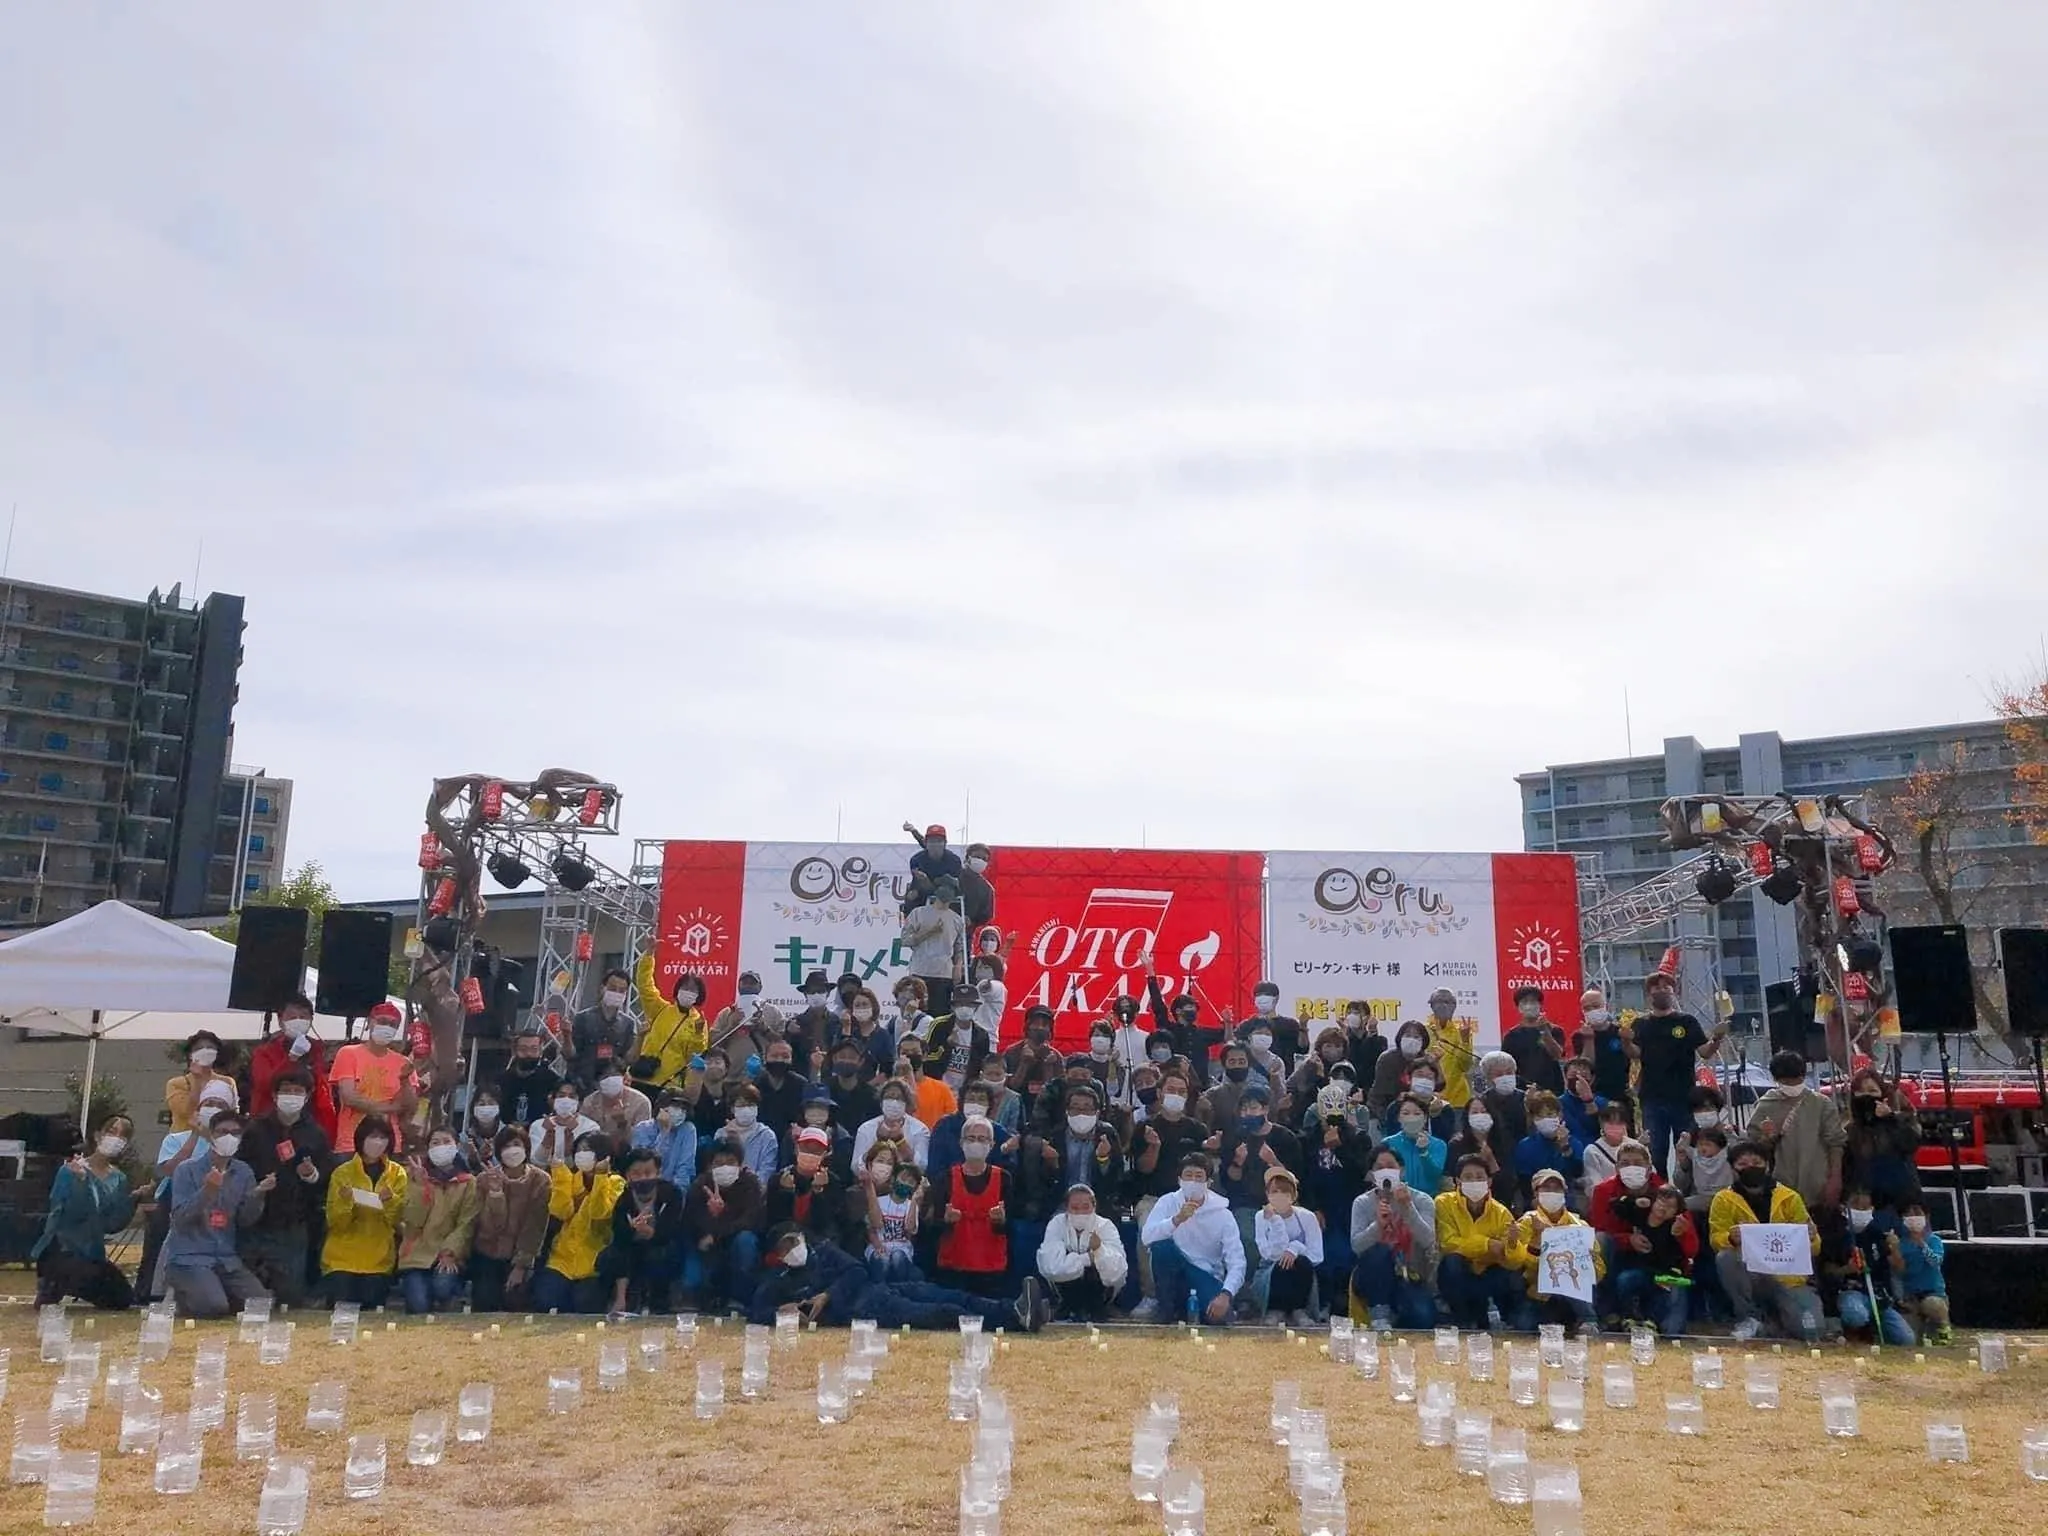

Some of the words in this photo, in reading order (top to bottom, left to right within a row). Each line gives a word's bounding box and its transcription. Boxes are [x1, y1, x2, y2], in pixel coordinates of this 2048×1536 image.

[1313, 867, 1454, 915] aeru
[1035, 925, 1157, 969] OTO
[663, 965, 729, 976] OTOAKARI
[1387, 961, 1401, 976] 様
